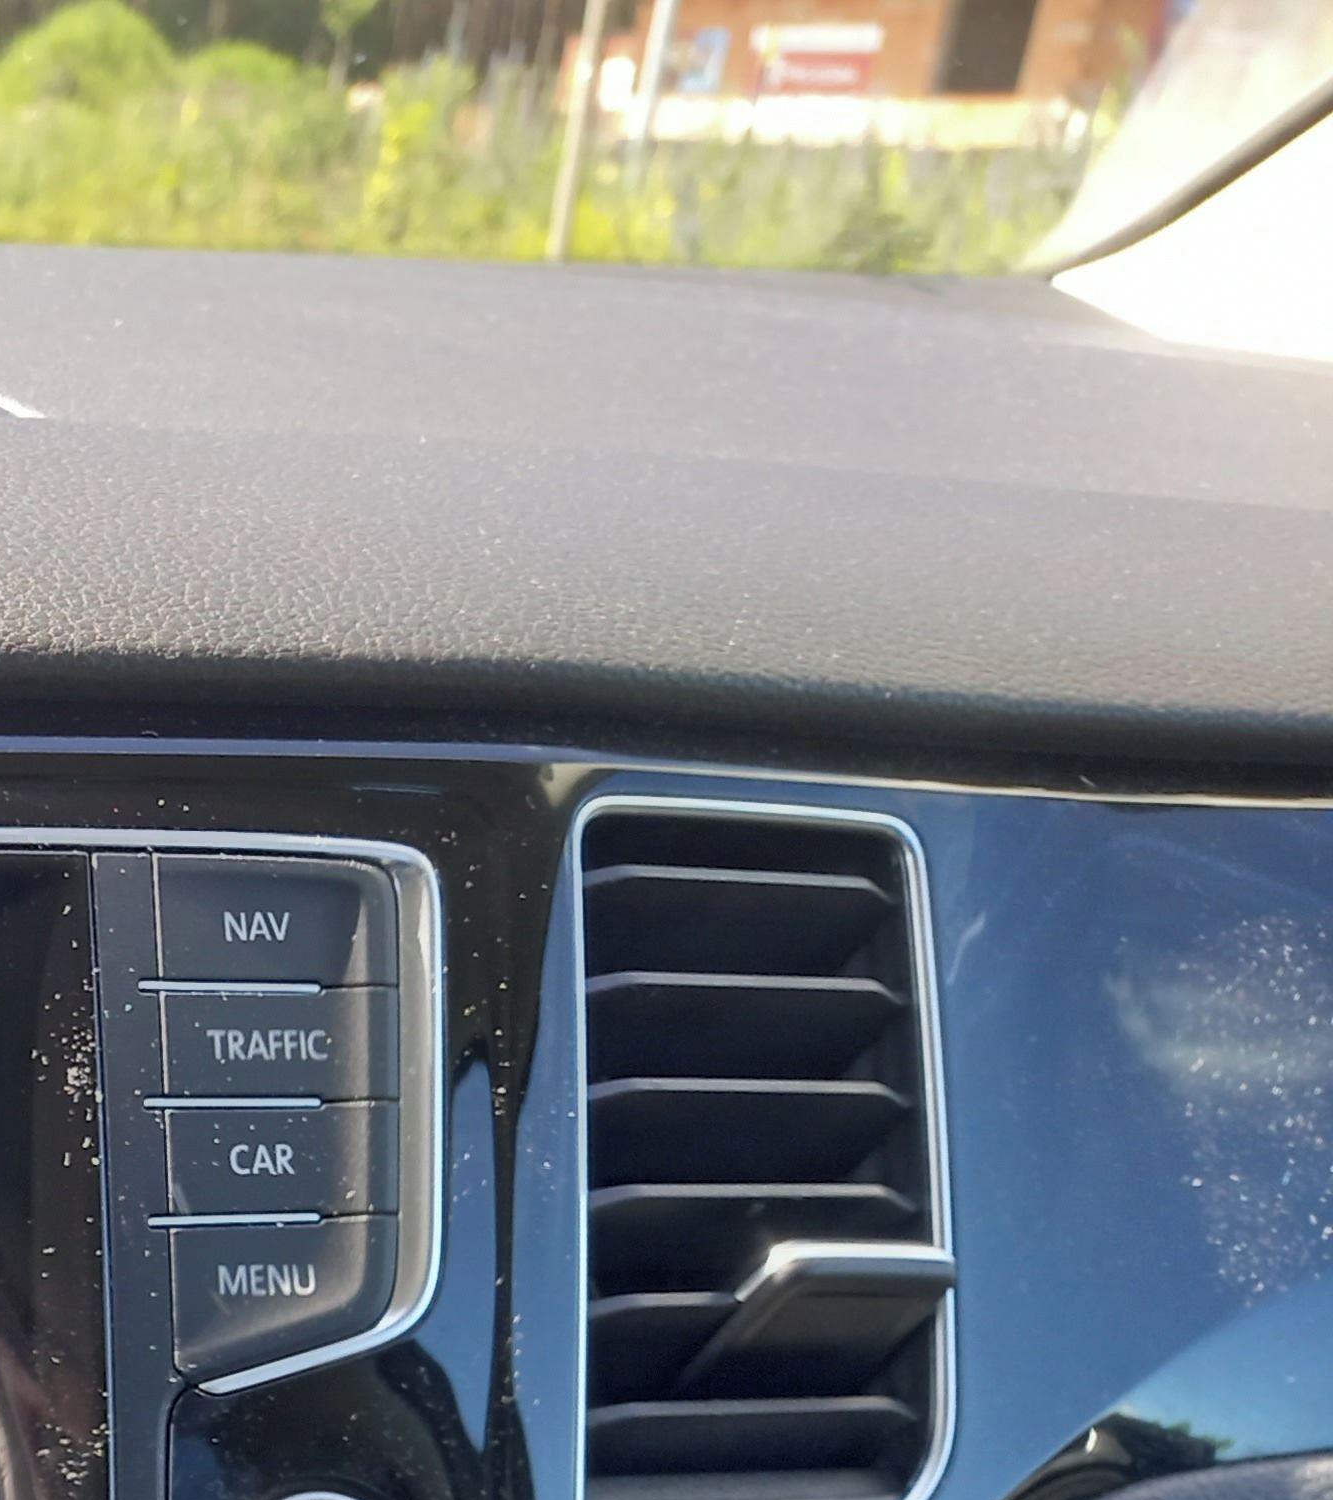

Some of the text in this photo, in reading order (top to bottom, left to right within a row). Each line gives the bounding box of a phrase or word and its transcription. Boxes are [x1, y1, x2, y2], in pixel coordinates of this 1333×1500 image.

[223, 911, 291, 943] NAV
[206, 1029, 330, 1061] TRAFFIC
[229, 1144, 296, 1176] CAR
[218, 1263, 317, 1297] MENU
